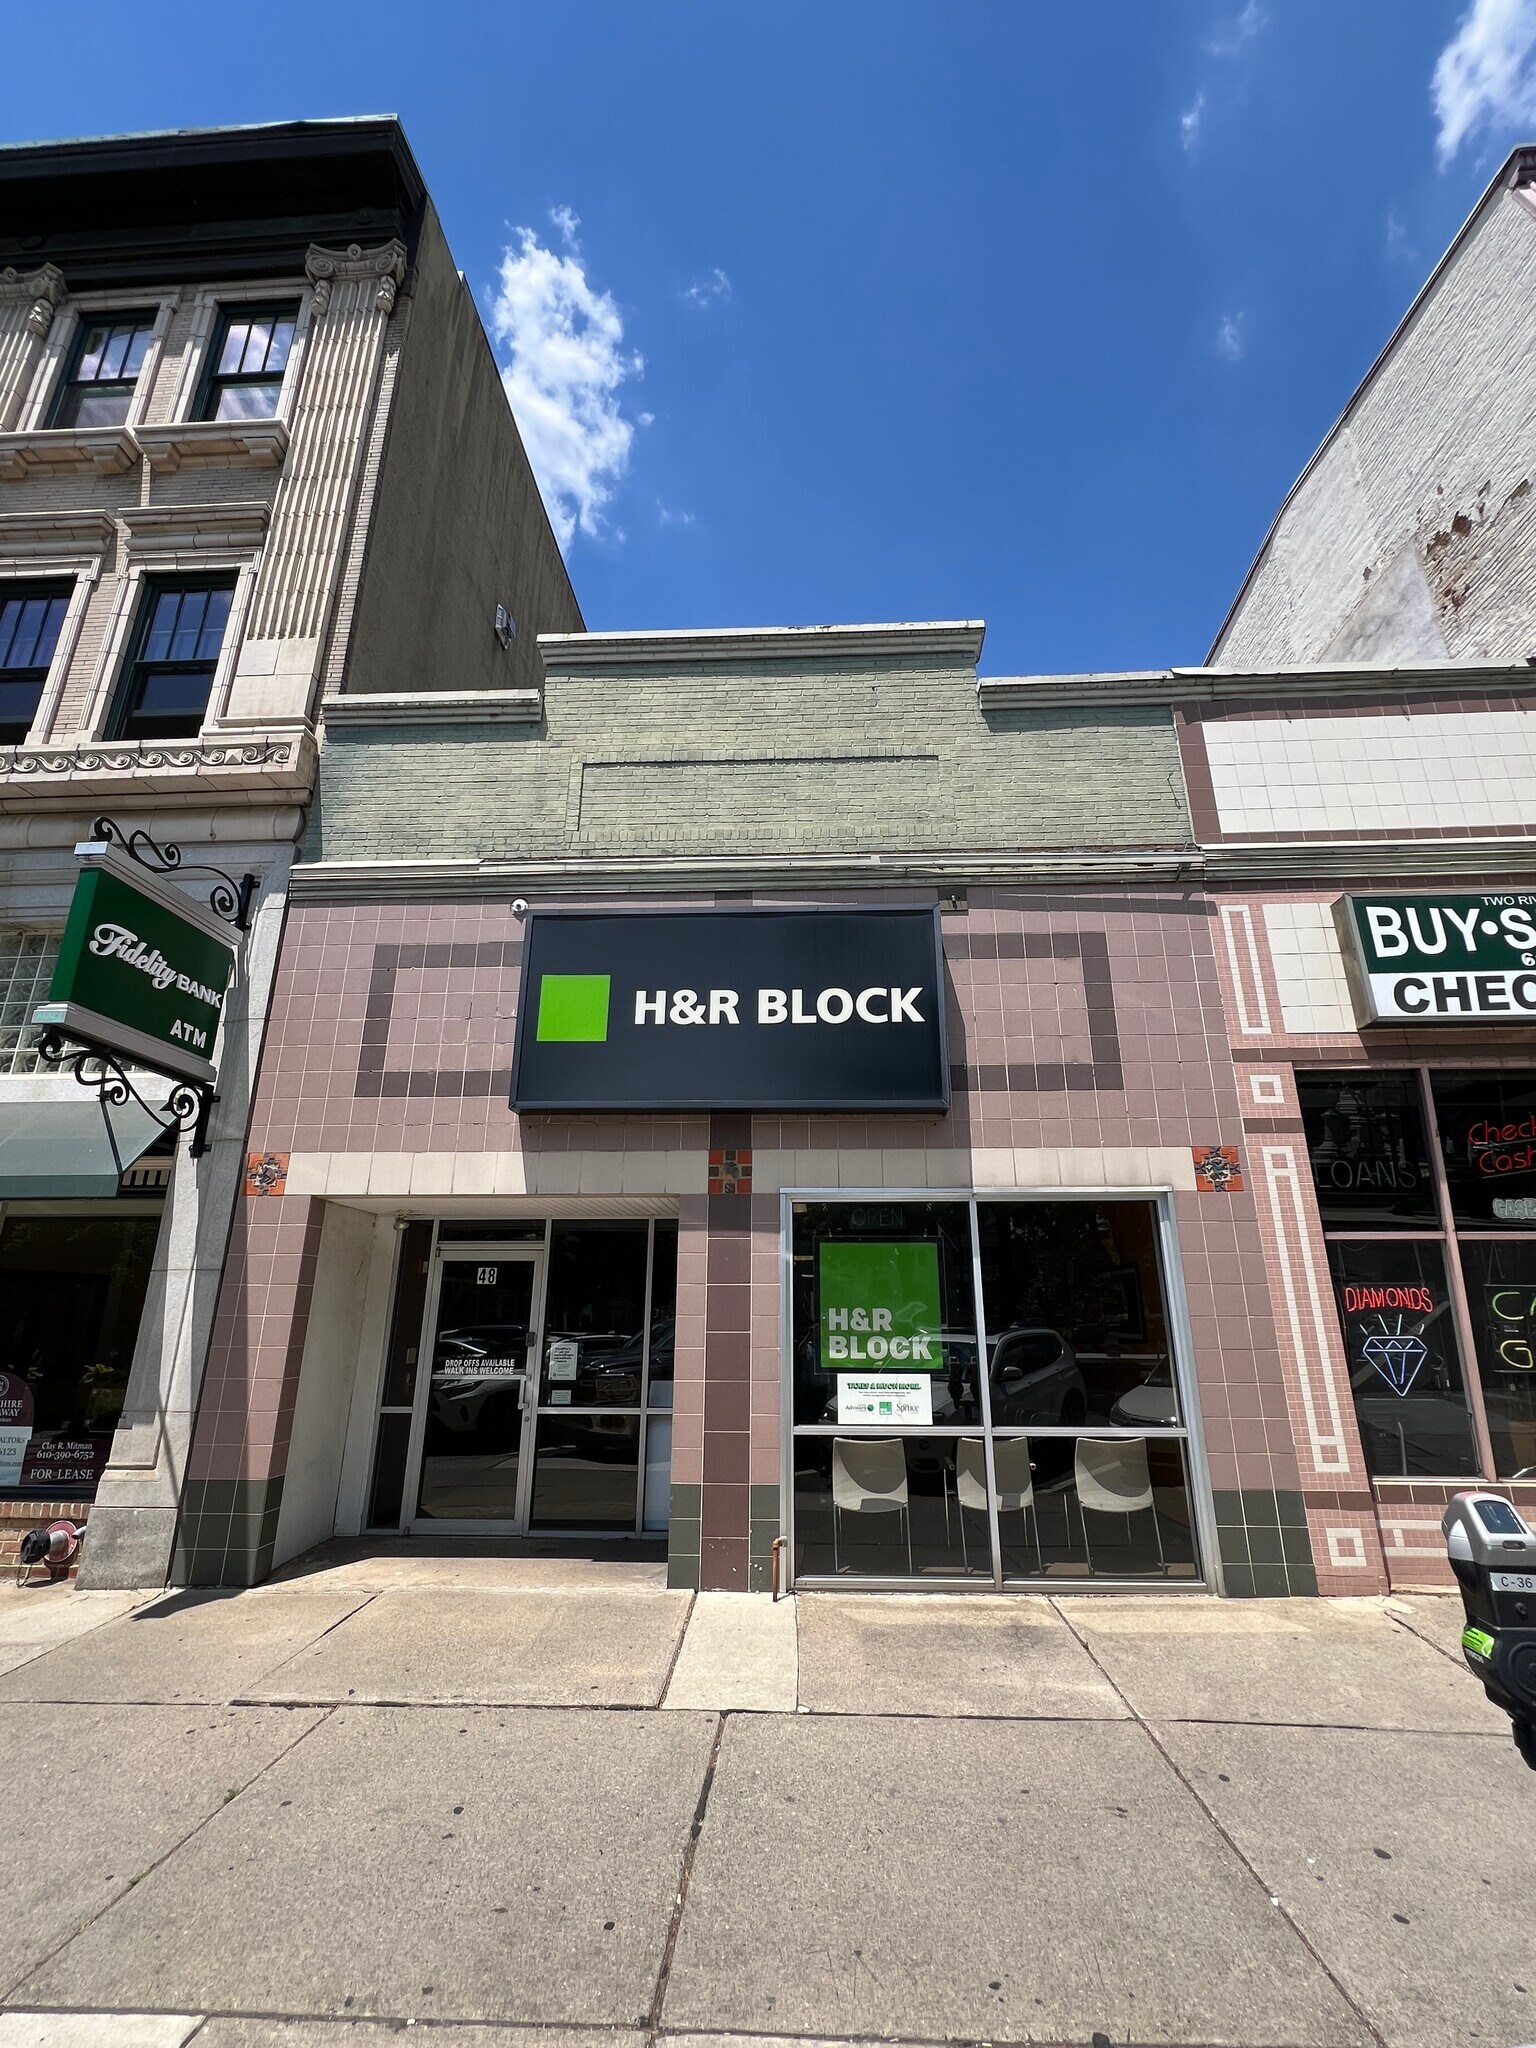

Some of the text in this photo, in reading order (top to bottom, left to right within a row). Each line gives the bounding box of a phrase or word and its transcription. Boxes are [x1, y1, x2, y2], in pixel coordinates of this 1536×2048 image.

[1481, 896, 1515, 906] TWO
[89, 923, 222, 1009] Fidelity BANK
[634, 987, 926, 1025] H&R BLOCK
[170, 1019, 207, 1049] ATM
[1314, 1160, 1417, 1188] LOANS
[852, 1207, 904, 1228] OPEN
[479, 1268, 496, 1284] 48
[1345, 1287, 1434, 1313] DIAMONDS
[828, 1307, 893, 1331] H&R
[829, 1336, 933, 1360] BLOCK
[444, 1367, 464, 1375] WALK
[479, 1367, 514, 1375] WELCOME
[445, 1359, 515, 1367] DROP OFFS AVAILABLE
[36, 1450, 95, 1460] 610-390-6752
[41, 1441, 57, 1451] Clay
[30, 1469, 94, 1480] FOR LEASE
[1501, 1576, 1533, 1588] C-36
